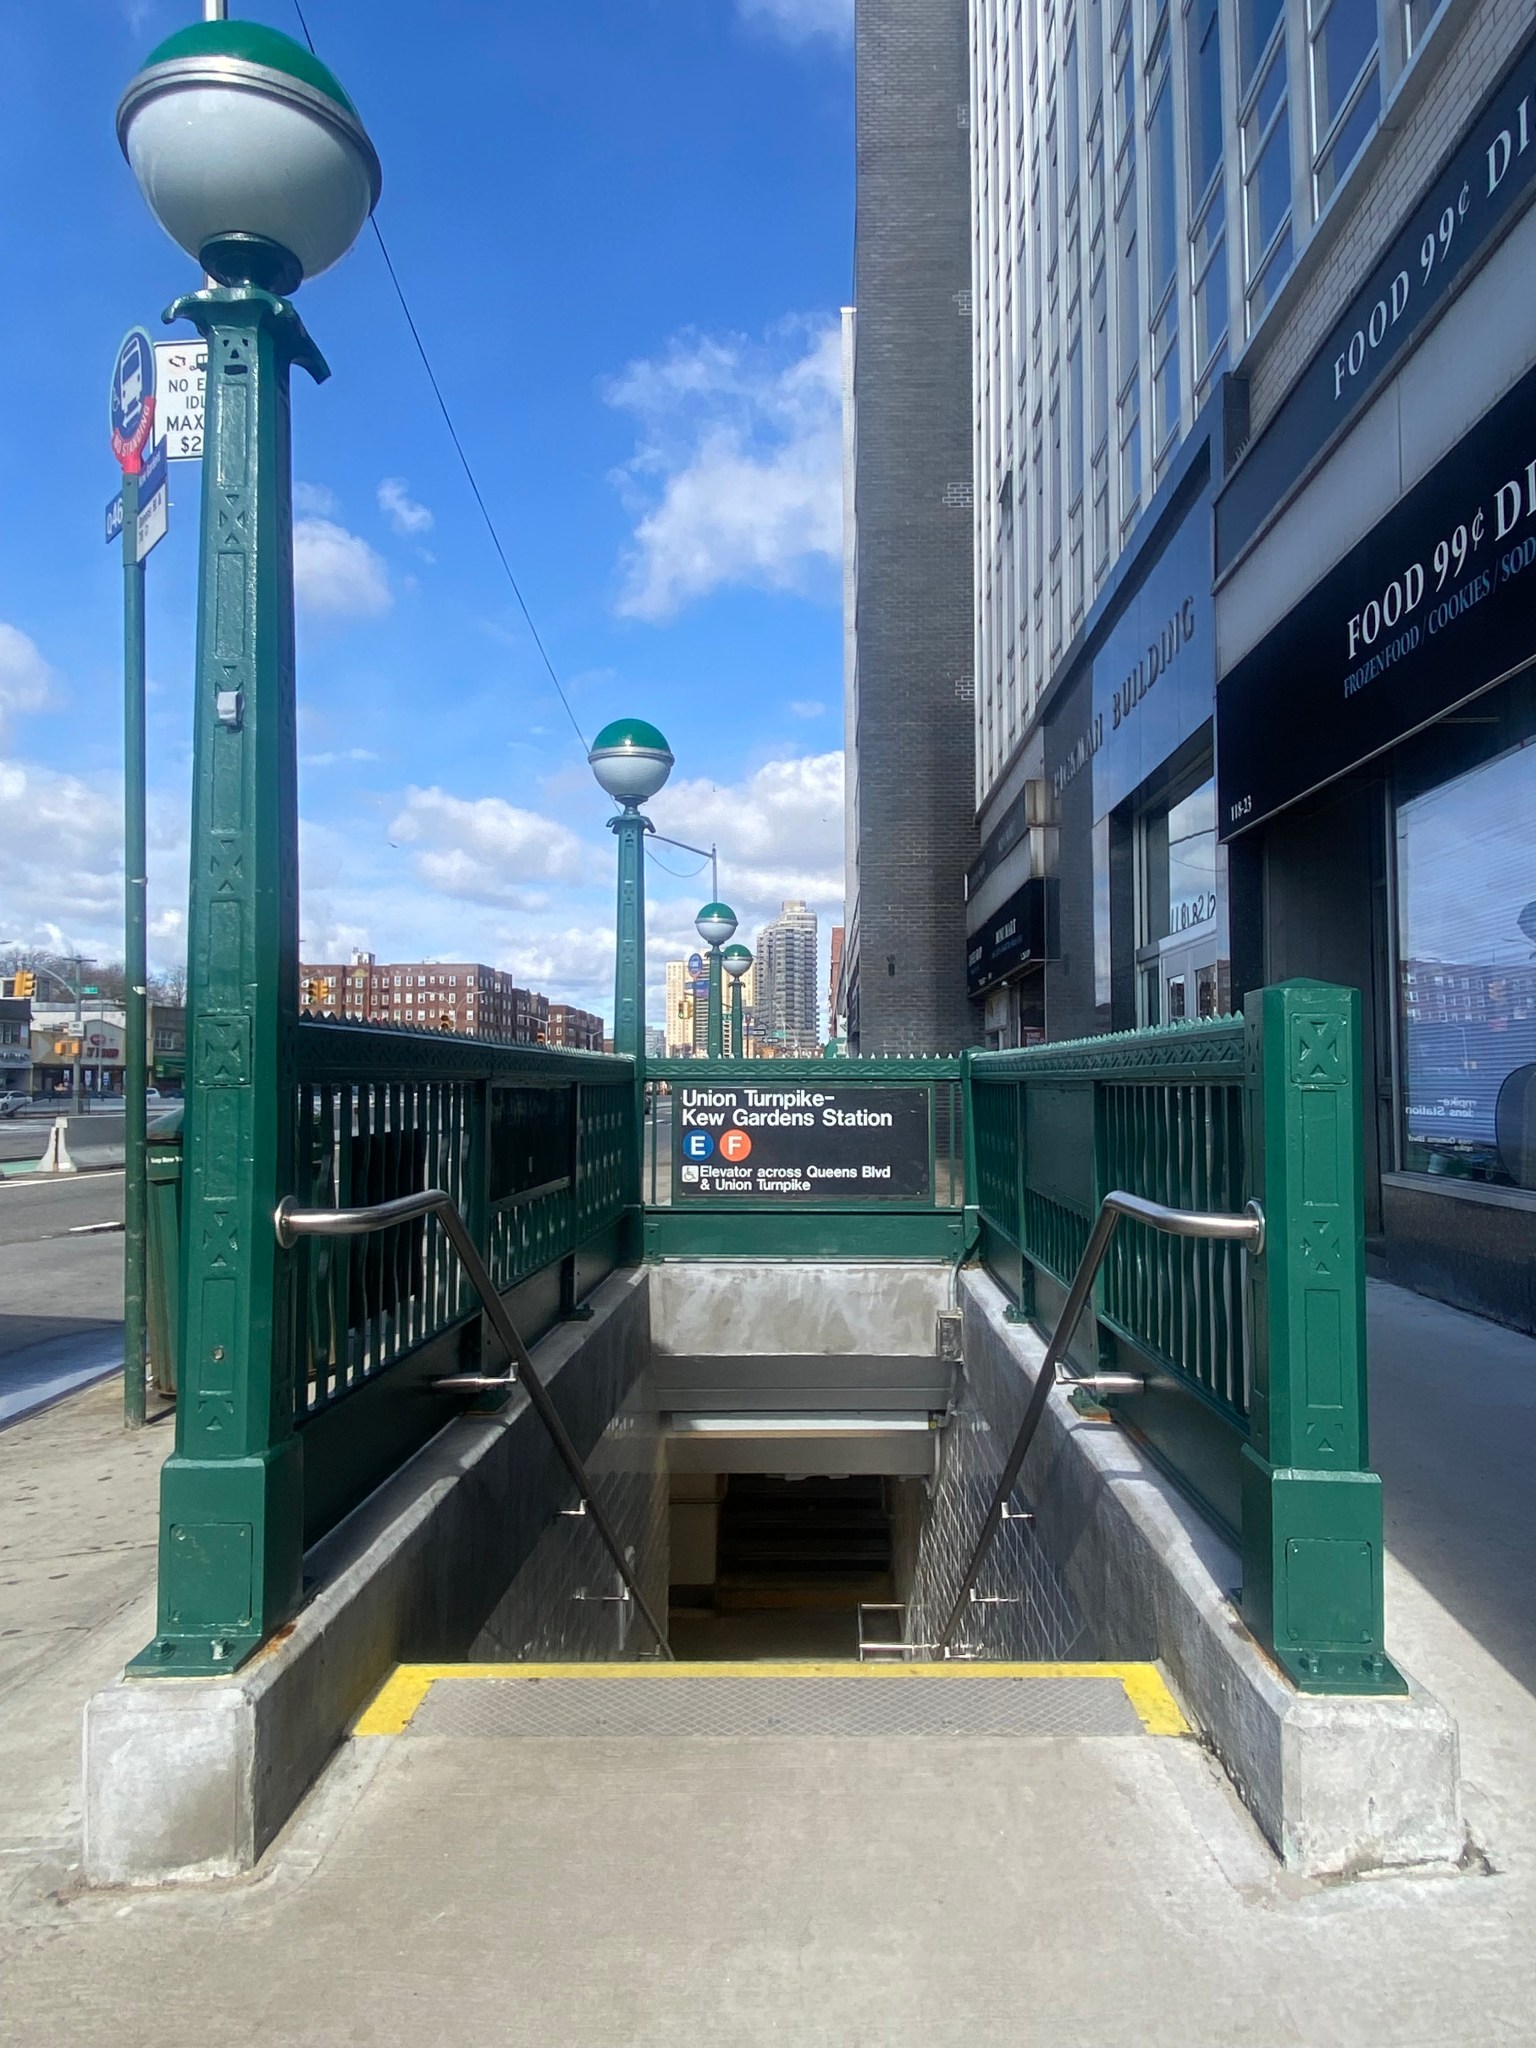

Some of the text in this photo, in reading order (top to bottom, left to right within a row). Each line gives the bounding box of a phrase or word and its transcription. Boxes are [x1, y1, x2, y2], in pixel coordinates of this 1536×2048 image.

[1334, 270, 1410, 400] FOOD
[1420, 180, 1471, 287] 99¢
[168, 378, 189, 393] NO
[185, 394, 206, 409] IDL
[166, 414, 204, 432] MAX
[180, 435, 202, 454] $2
[1346, 563, 1424, 660] FOOD
[1433, 507, 1484, 593] 99¢
[1428, 569, 1491, 635] COOKIES
[1112, 596, 1195, 730] BUILDING
[682, 1089, 835, 1110] Union Turnpike-
[682, 1108, 892, 1127] Kew Gardens Station
[691, 1136, 742, 1155] E F
[700, 1166, 891, 1179] Elevator across Queens Blvd
[700, 1179, 811, 1193] & Union Turnpike
